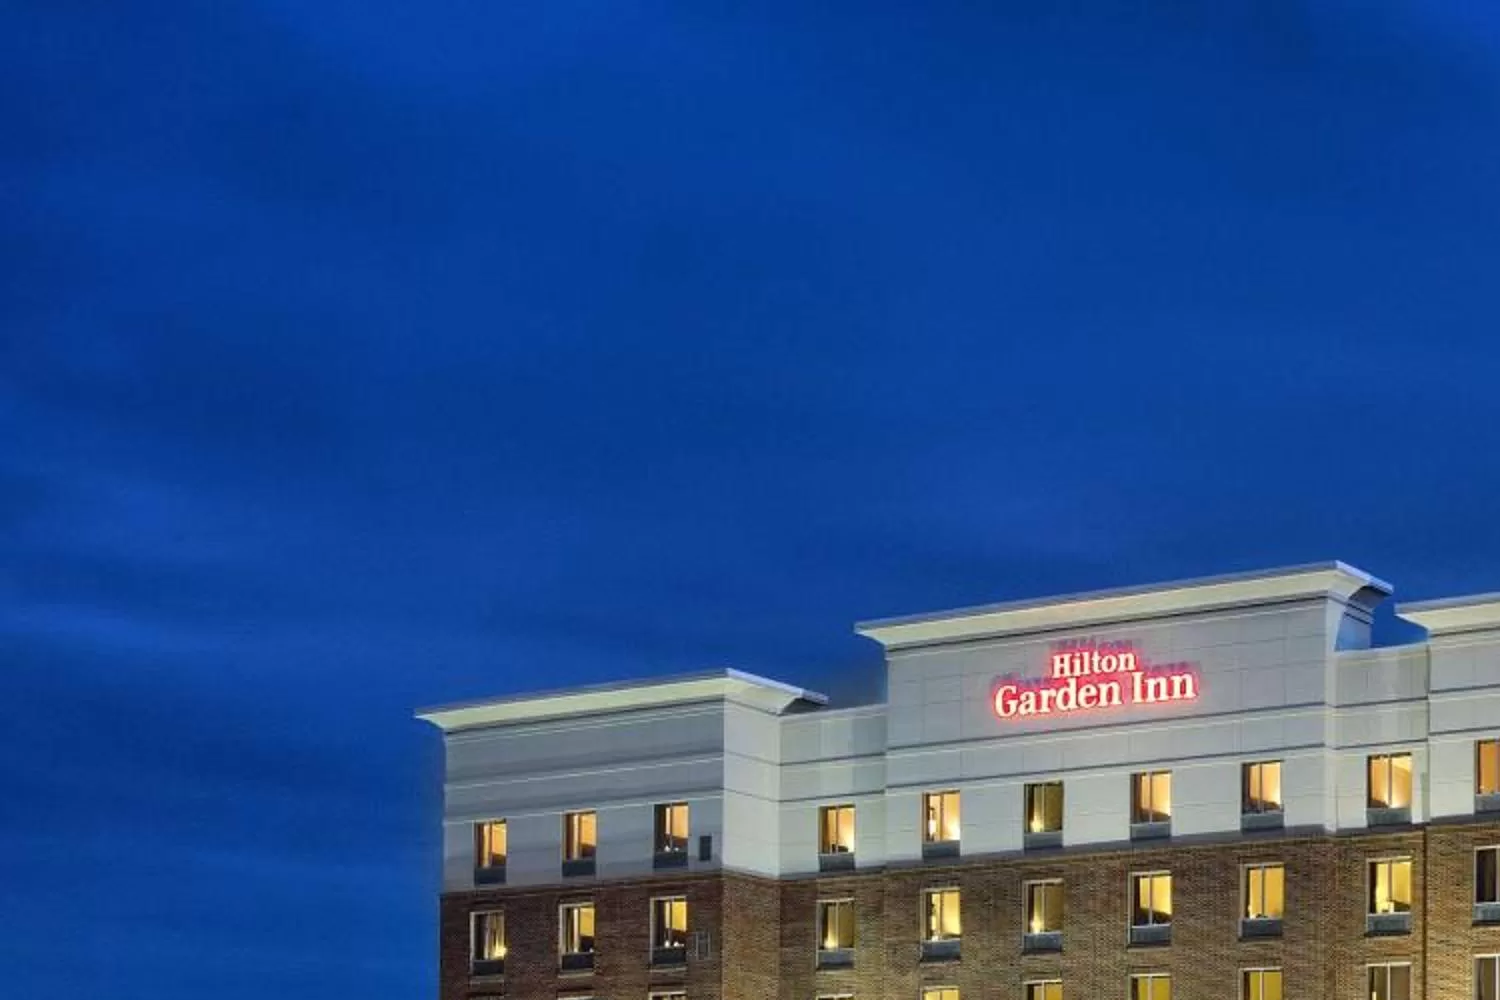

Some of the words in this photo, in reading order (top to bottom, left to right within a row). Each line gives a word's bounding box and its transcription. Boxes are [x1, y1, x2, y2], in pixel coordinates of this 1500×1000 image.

[1052, 651, 1136, 679] Hilton
[994, 678, 1122, 717] Garden
[1131, 671, 1197, 704] Inn
